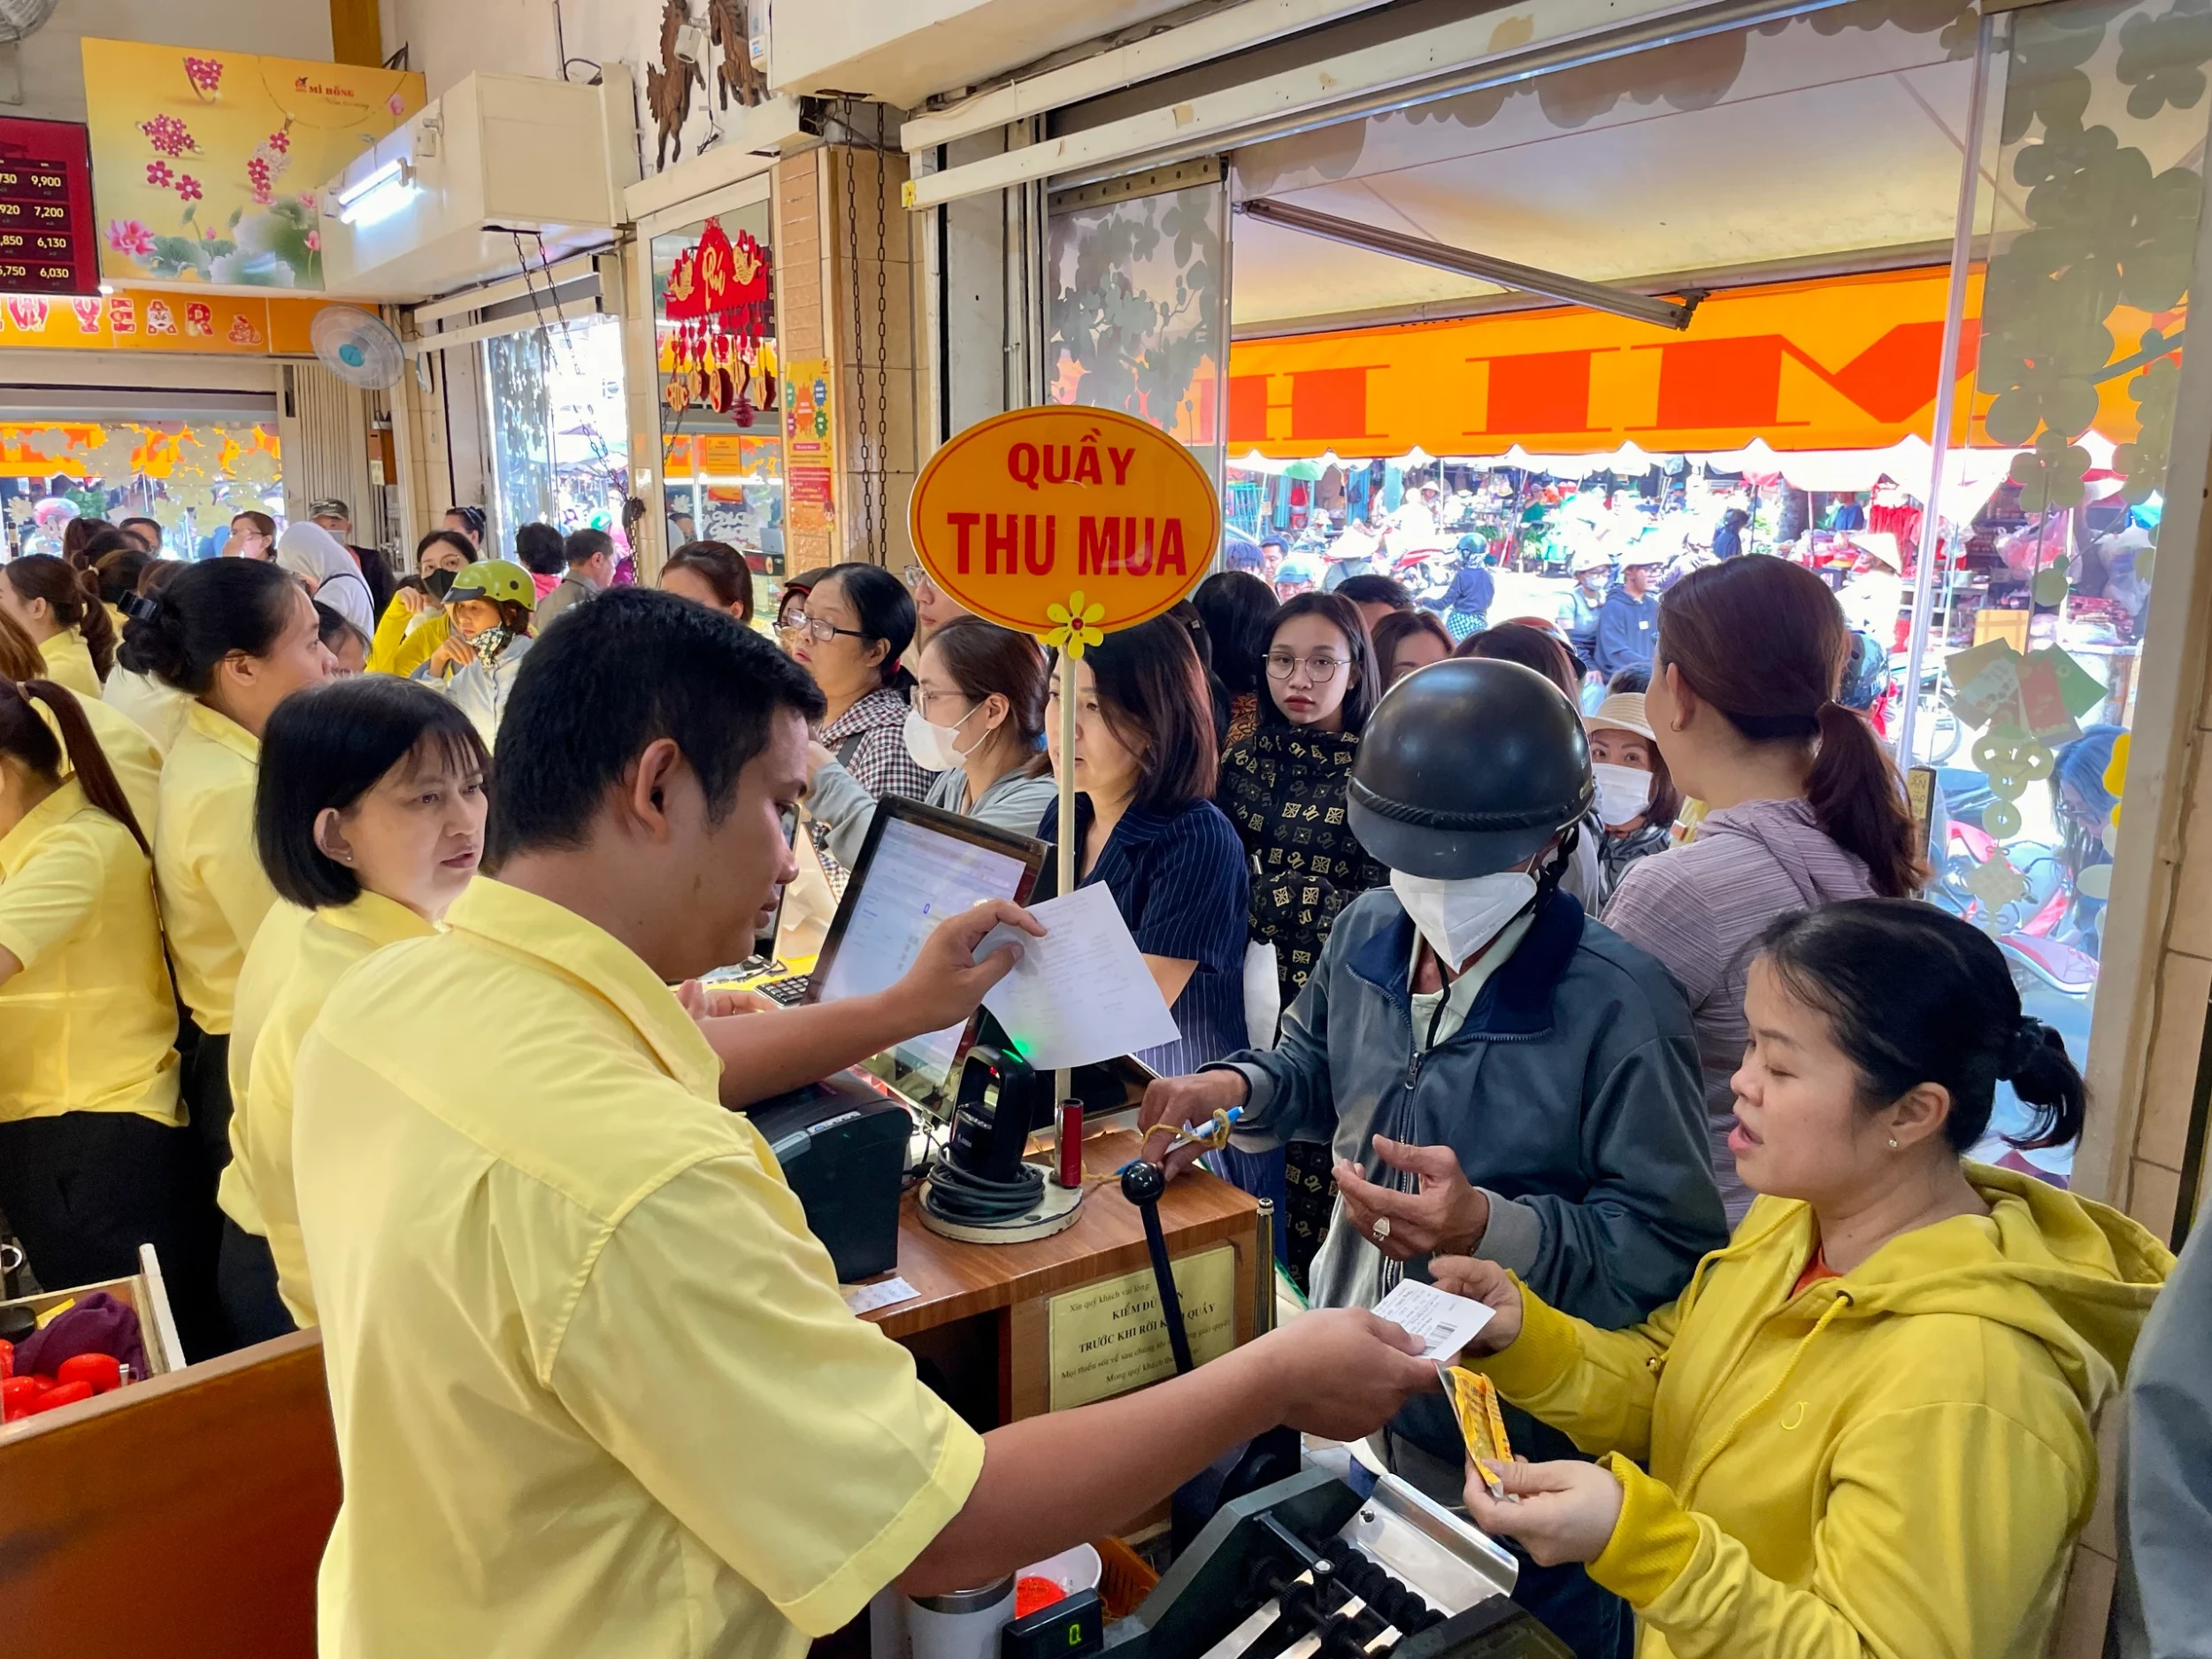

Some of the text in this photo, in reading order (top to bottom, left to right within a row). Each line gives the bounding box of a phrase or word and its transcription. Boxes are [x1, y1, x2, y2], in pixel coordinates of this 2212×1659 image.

[31, 175, 61, 188] 9,900
[35, 206, 64, 218] 7,200
[37, 237, 66, 249] 6,130
[40, 268, 69, 279] 6,030
[72, 296, 215, 337] YEAR
[1007, 427, 1136, 491] QUẦY
[947, 512, 1187, 577] THU MUA
[1118, 1327, 1137, 1341] KHI
